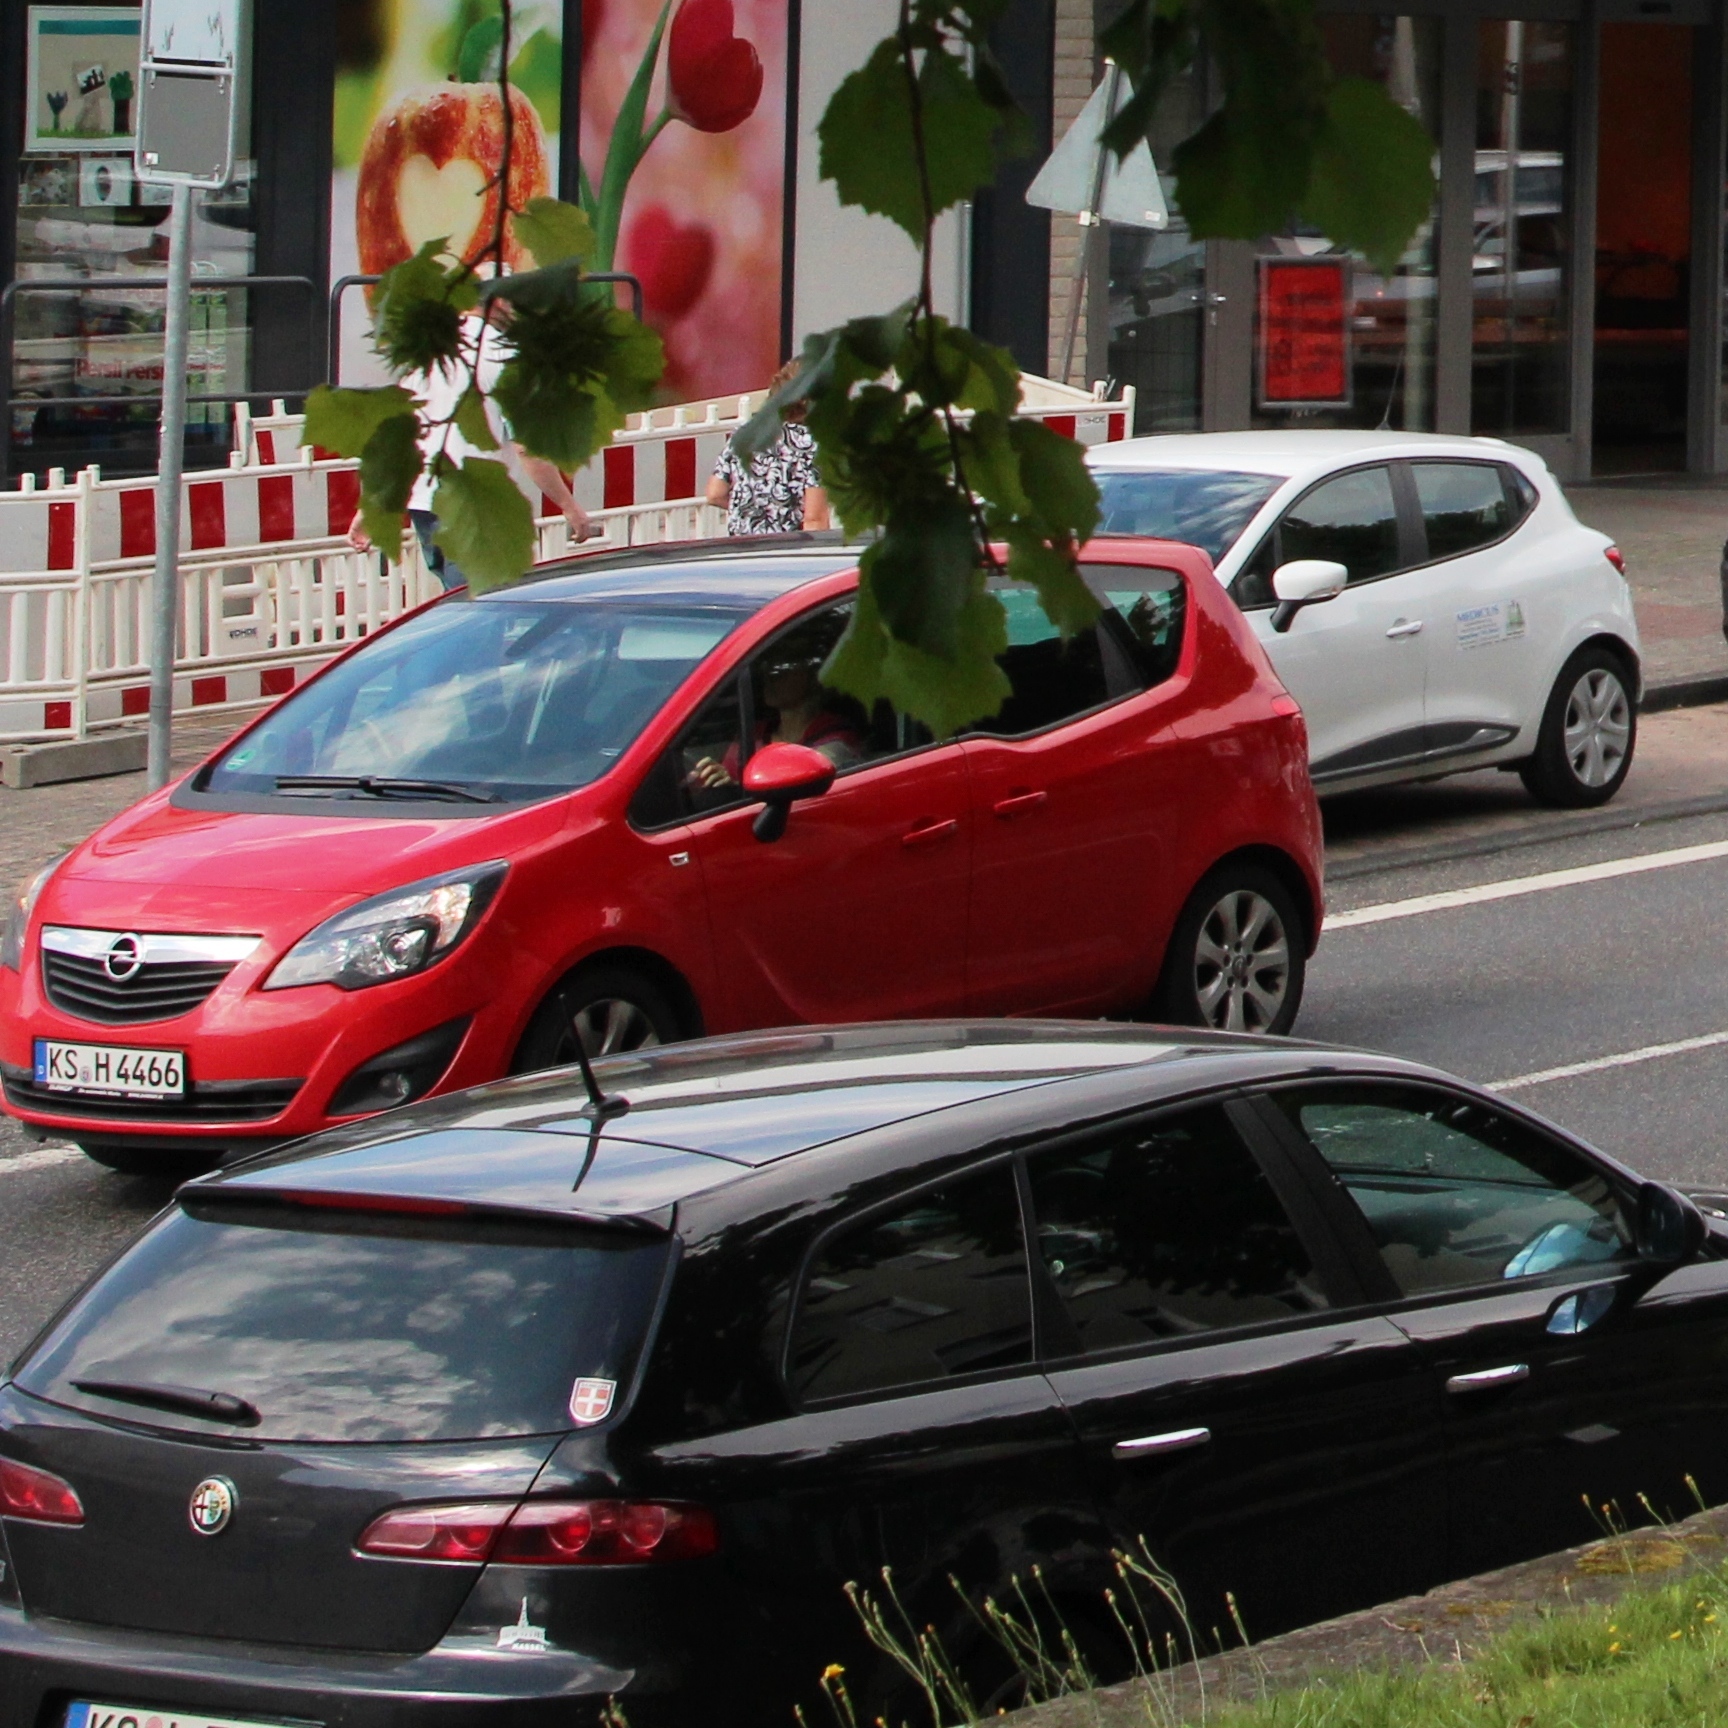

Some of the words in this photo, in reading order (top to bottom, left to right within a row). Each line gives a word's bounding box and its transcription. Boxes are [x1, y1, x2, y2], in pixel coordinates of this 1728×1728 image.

[49, 1048, 78, 1080] KS
[95, 1052, 110, 1083] H
[116, 1054, 180, 1088] 4466
